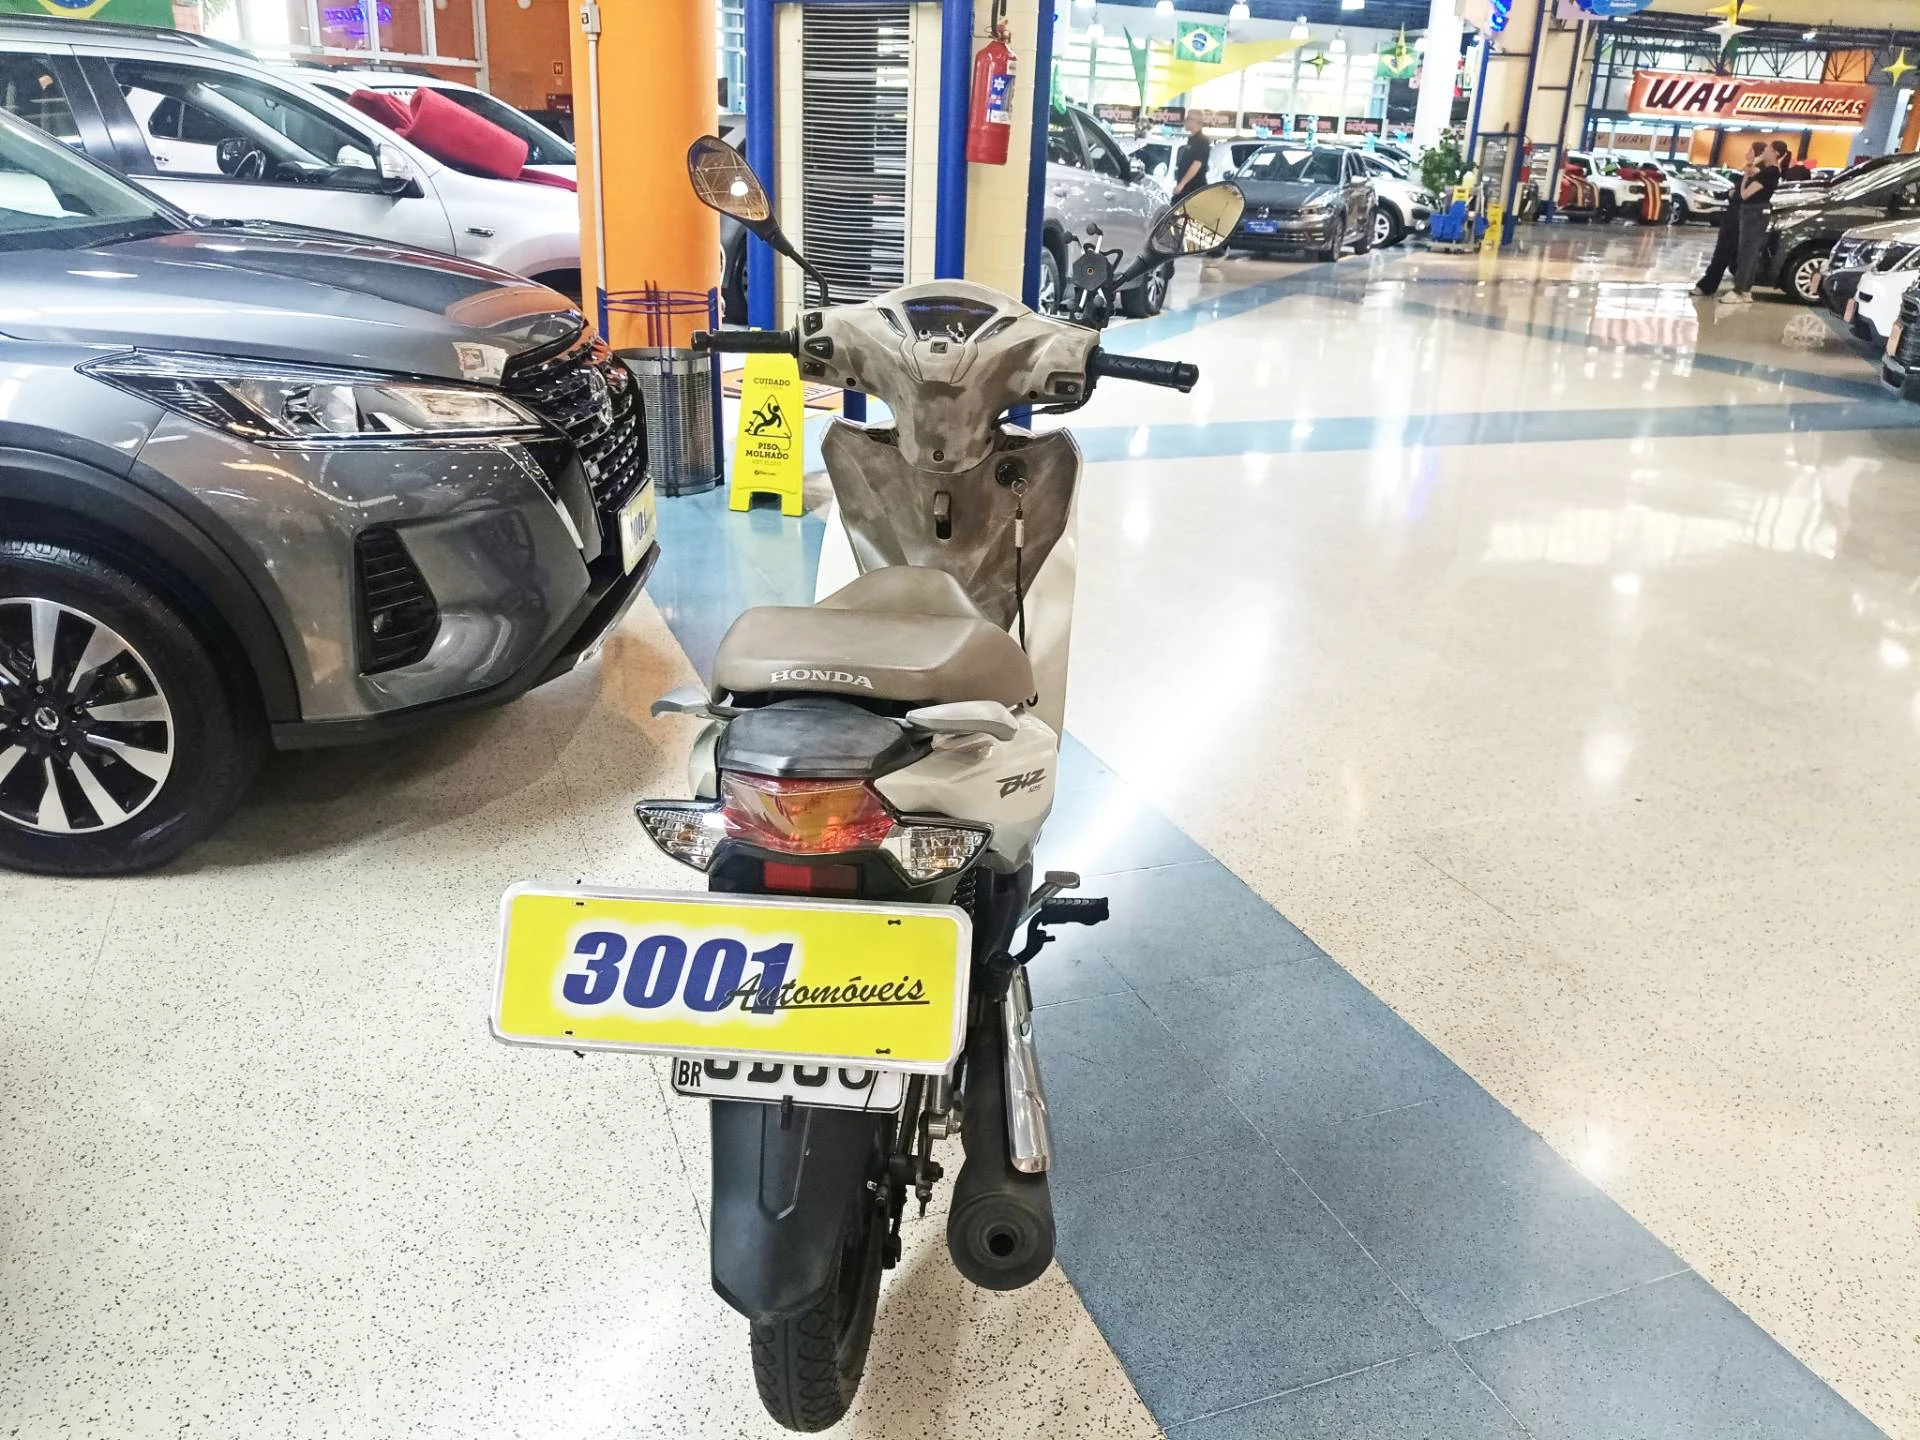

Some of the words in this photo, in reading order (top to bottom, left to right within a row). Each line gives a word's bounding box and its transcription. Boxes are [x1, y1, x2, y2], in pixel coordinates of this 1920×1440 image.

[1645, 78, 1741, 113] WAY
[1737, 92, 1868, 117] MULTIMARCAS
[753, 377, 791, 386] CUIDADO
[745, 449, 789, 460] MOLHADO
[758, 442, 779, 451] PISO
[769, 669, 874, 690] HONDA
[562, 931, 794, 1015] 3001
[716, 973, 930, 1011] Automóveis
[677, 1060, 701, 1087] BR
